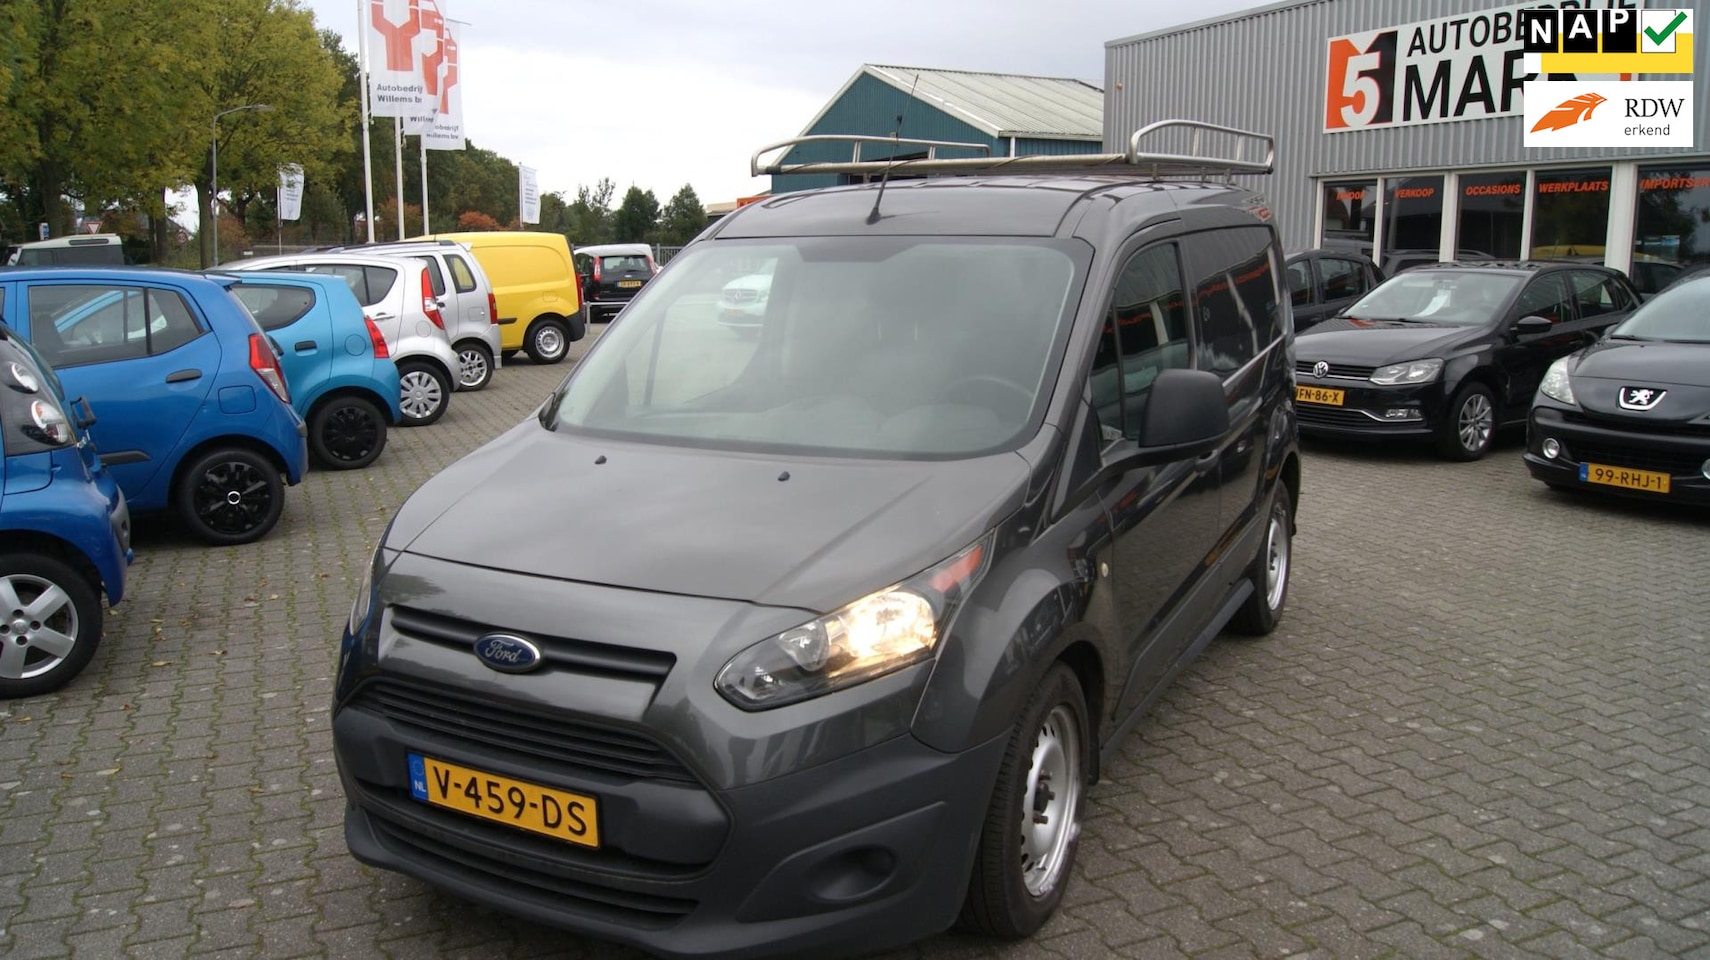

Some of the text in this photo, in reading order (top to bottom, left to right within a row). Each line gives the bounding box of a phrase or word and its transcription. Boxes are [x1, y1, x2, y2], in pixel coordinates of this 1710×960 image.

[1402, 48, 1578, 122] MAR
[377, 95, 413, 103] Willems
[1395, 187, 1434, 198] VERKOOP
[1465, 184, 1521, 196] OCCASIONS
[1538, 181, 1608, 193] WERKPLAATS
[1595, 468, 1662, 489] 99-RHJ-1
[485, 639, 523, 663] Ford
[414, 780, 427, 793] NL
[433, 766, 588, 836] V-459-DS
